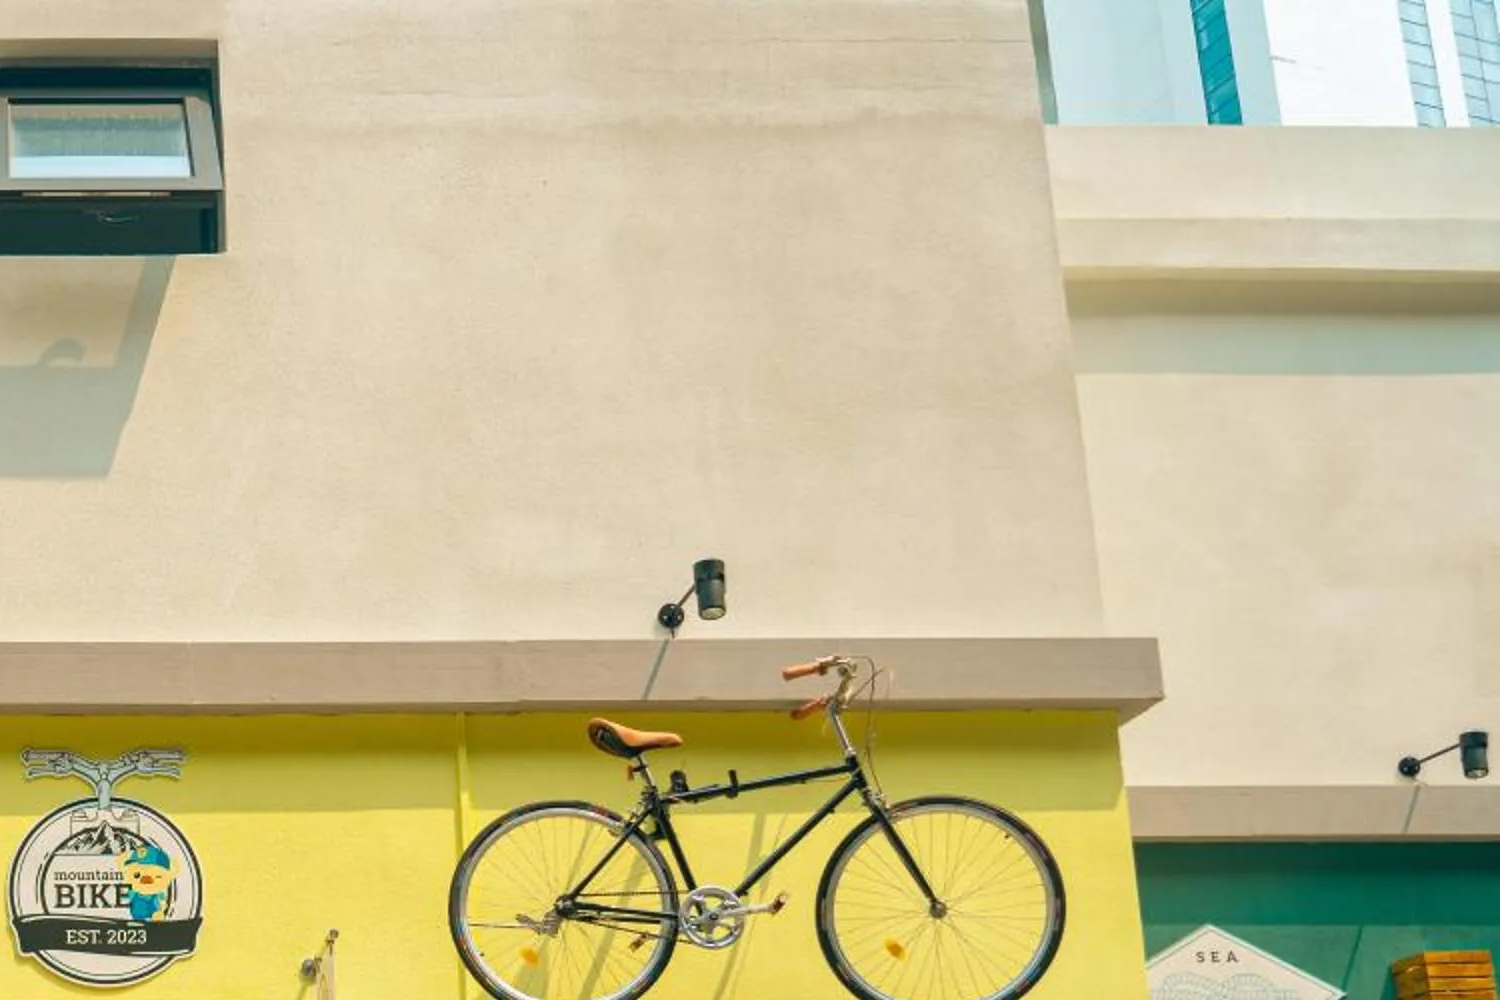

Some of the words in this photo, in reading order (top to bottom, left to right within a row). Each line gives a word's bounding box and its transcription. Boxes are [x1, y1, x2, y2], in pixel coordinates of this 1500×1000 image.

[53, 868, 124, 881] mountain
[53, 883, 132, 909] BIKE
[66, 929, 102, 945] EST.
[107, 929, 147, 944] 2023
[1195, 950, 1239, 963] SEA
